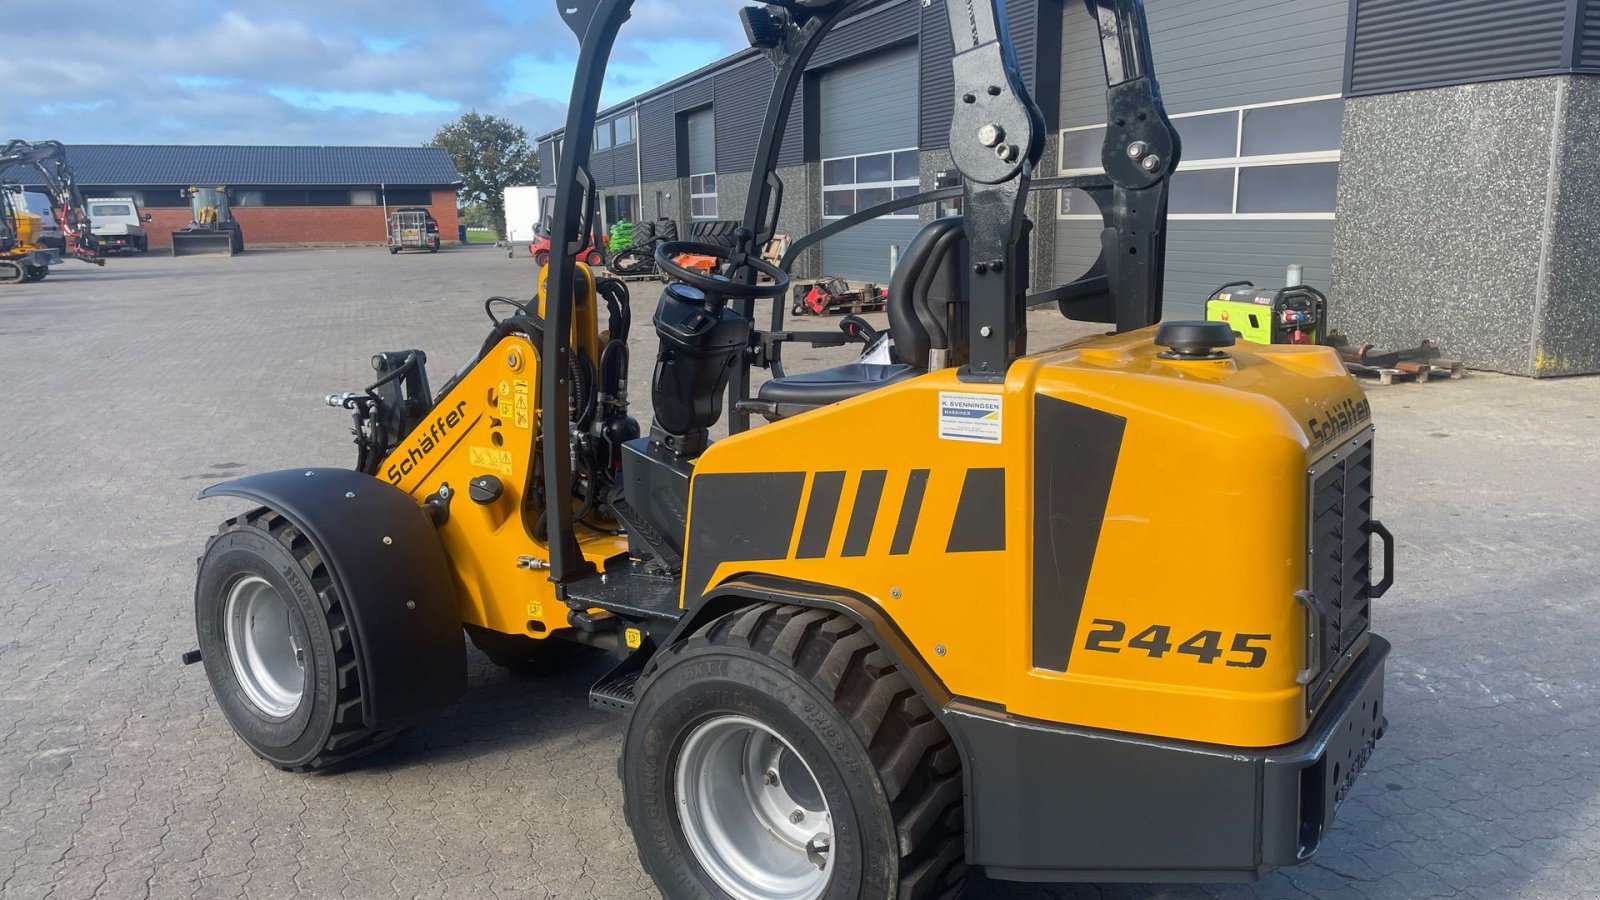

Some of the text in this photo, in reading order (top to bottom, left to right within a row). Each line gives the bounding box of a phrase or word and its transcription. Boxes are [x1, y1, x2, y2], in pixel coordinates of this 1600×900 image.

[1064, 198, 1071, 213] 3
[949, 401, 1000, 410] SVENNINGSEN
[1309, 398, 1372, 442] Schäffer
[387, 400, 467, 486] Schäffer
[1084, 618, 1272, 668] 2445
